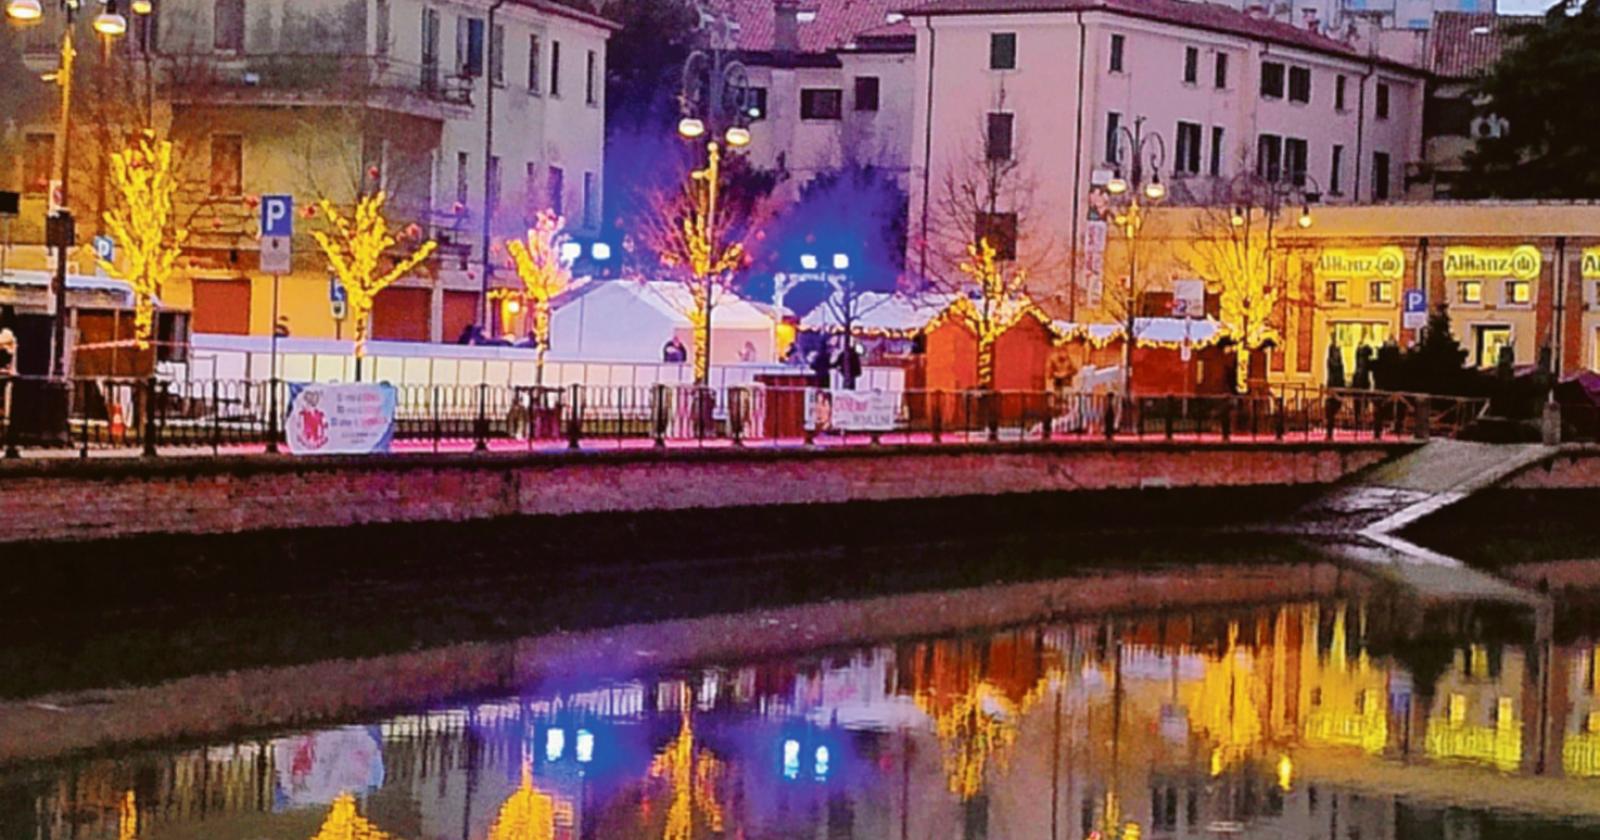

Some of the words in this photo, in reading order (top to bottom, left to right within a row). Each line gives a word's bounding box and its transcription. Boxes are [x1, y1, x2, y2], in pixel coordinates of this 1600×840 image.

[266, 200, 285, 232] P
[1315, 255, 1372, 271] Allianz
[1446, 254, 1508, 272] Allianz
[1408, 292, 1423, 310] P
